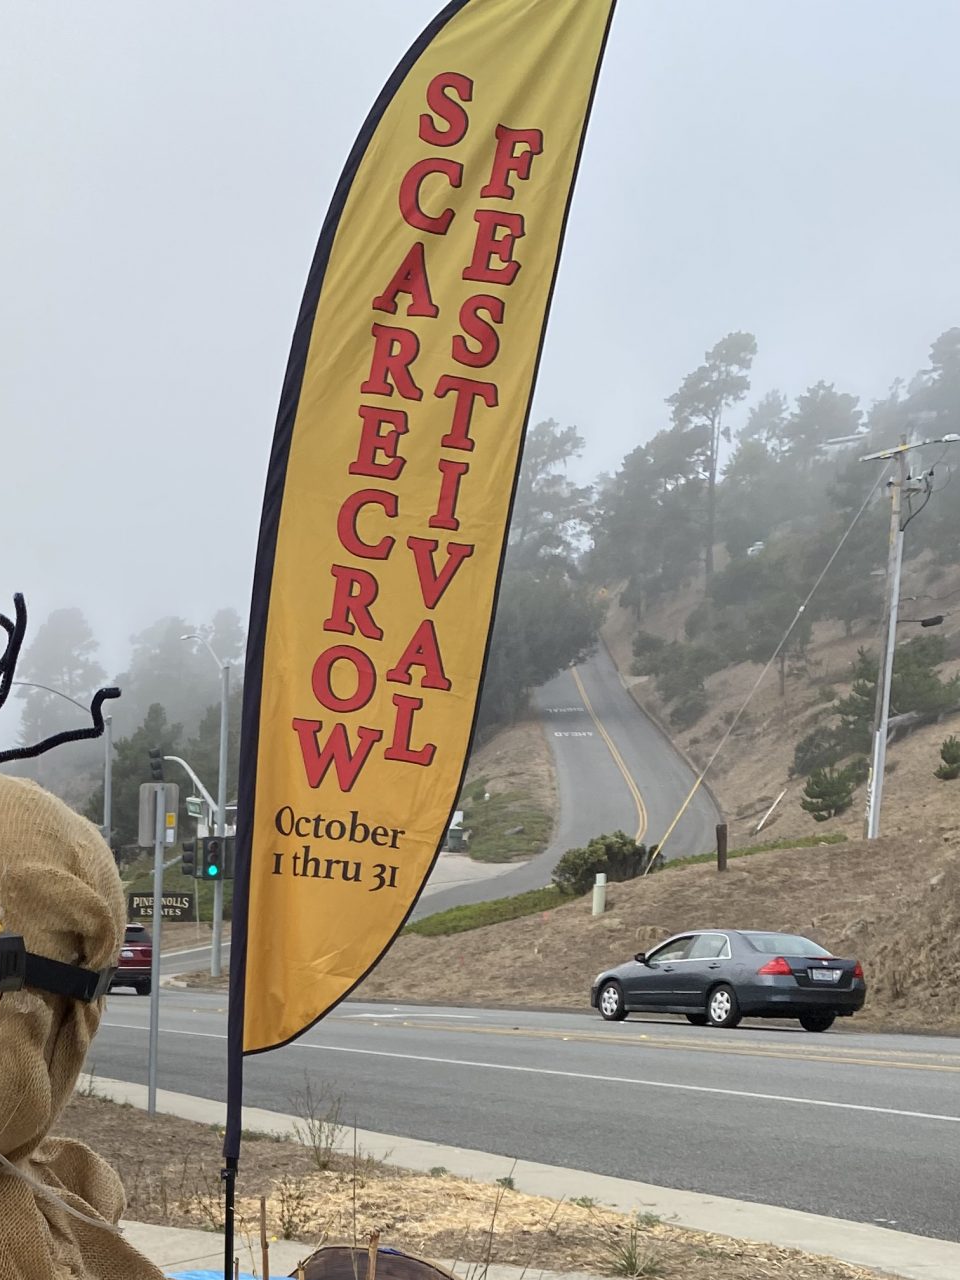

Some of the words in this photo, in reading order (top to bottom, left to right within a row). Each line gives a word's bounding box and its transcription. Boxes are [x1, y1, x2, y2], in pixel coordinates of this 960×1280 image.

[292, 71, 474, 792] SCARECROW
[383, 123, 544, 767] FESTIVAL
[275, 805, 406, 849] October
[272, 852, 284, 875] 1
[292, 845, 362, 882] thru
[368, 863, 400, 892] 31
[133, 896, 154, 908] PINE
[159, 897, 190, 908] NOLLS
[140, 908, 181, 916] ESATES
